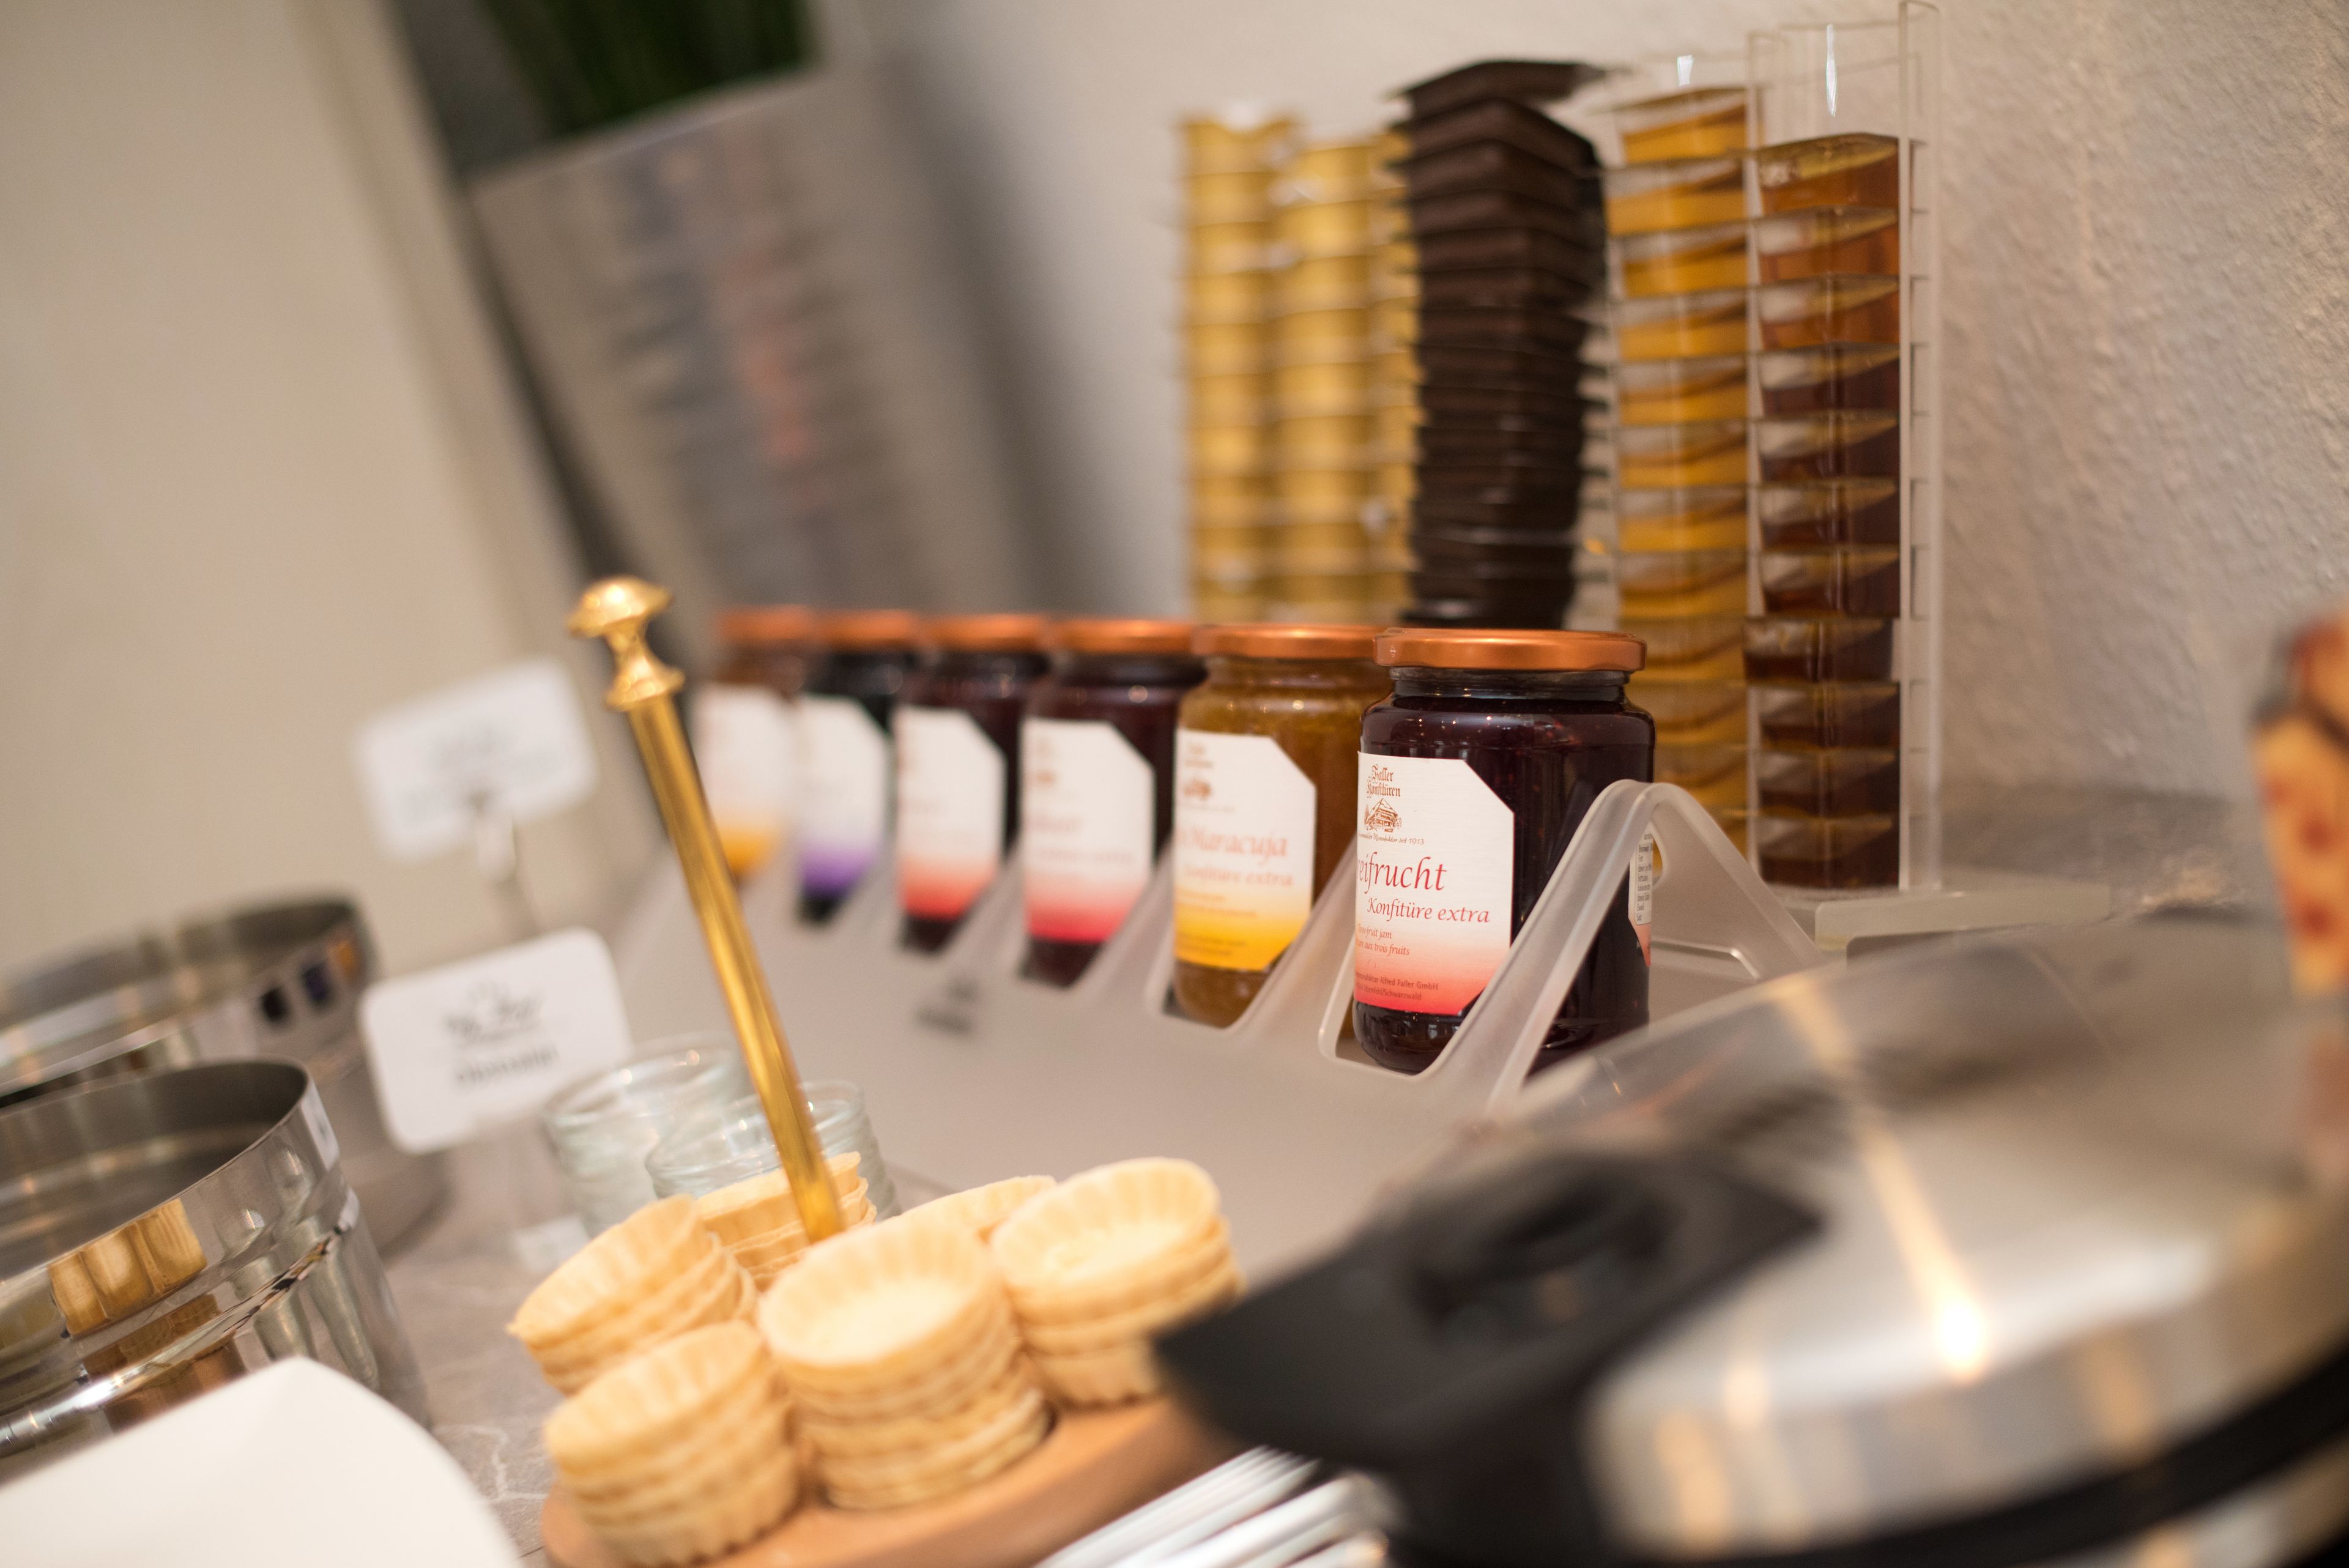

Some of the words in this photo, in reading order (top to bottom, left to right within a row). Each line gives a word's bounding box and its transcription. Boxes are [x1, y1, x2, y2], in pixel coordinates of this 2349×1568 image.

[1371, 764, 1394, 784] Faller
[1367, 776, 1401, 798] Konfitüren
[1367, 897, 1432, 921] Konfitüre
[1438, 907, 1491, 923] extra
[1378, 929, 1392, 940] jam
[1375, 943, 1387, 953] trois
[1387, 943, 1410, 956] fruits
[1380, 977, 1395, 986] Alfred
[1397, 979, 1414, 988] Faller
[1417, 981, 1438, 990] GmbH
